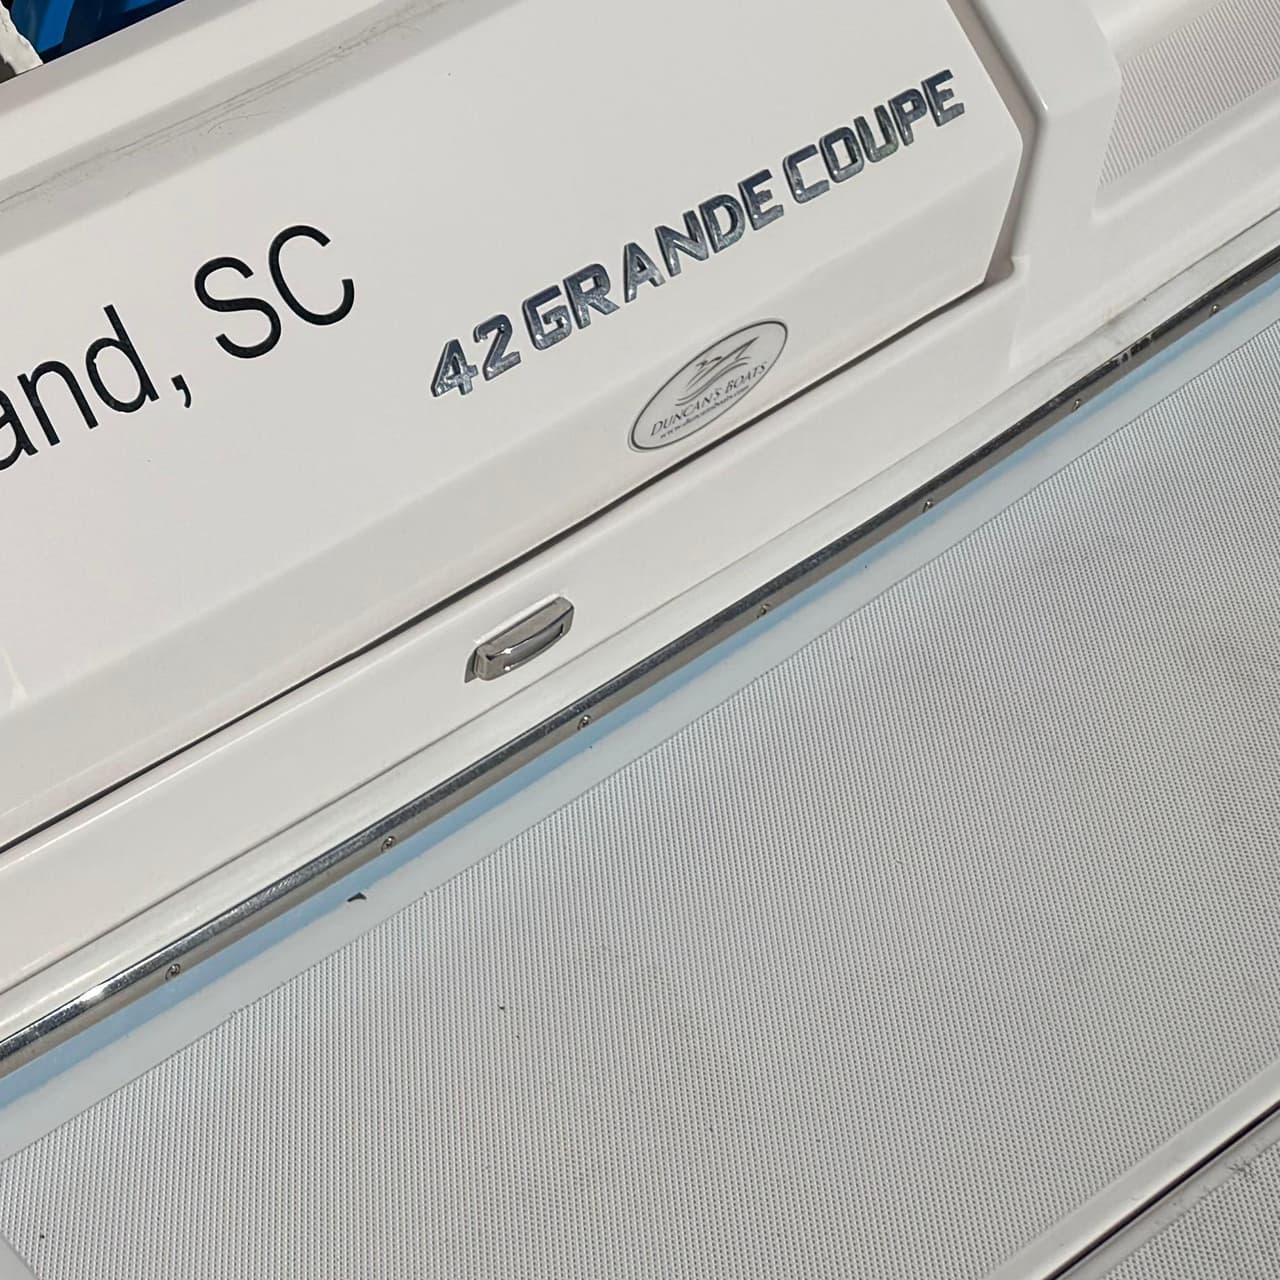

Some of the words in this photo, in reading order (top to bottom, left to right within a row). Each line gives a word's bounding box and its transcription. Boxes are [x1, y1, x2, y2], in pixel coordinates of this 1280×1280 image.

[782, 69, 966, 205] COUPE
[194, 225, 355, 359] SC
[724, 360, 768, 394] BOATS
